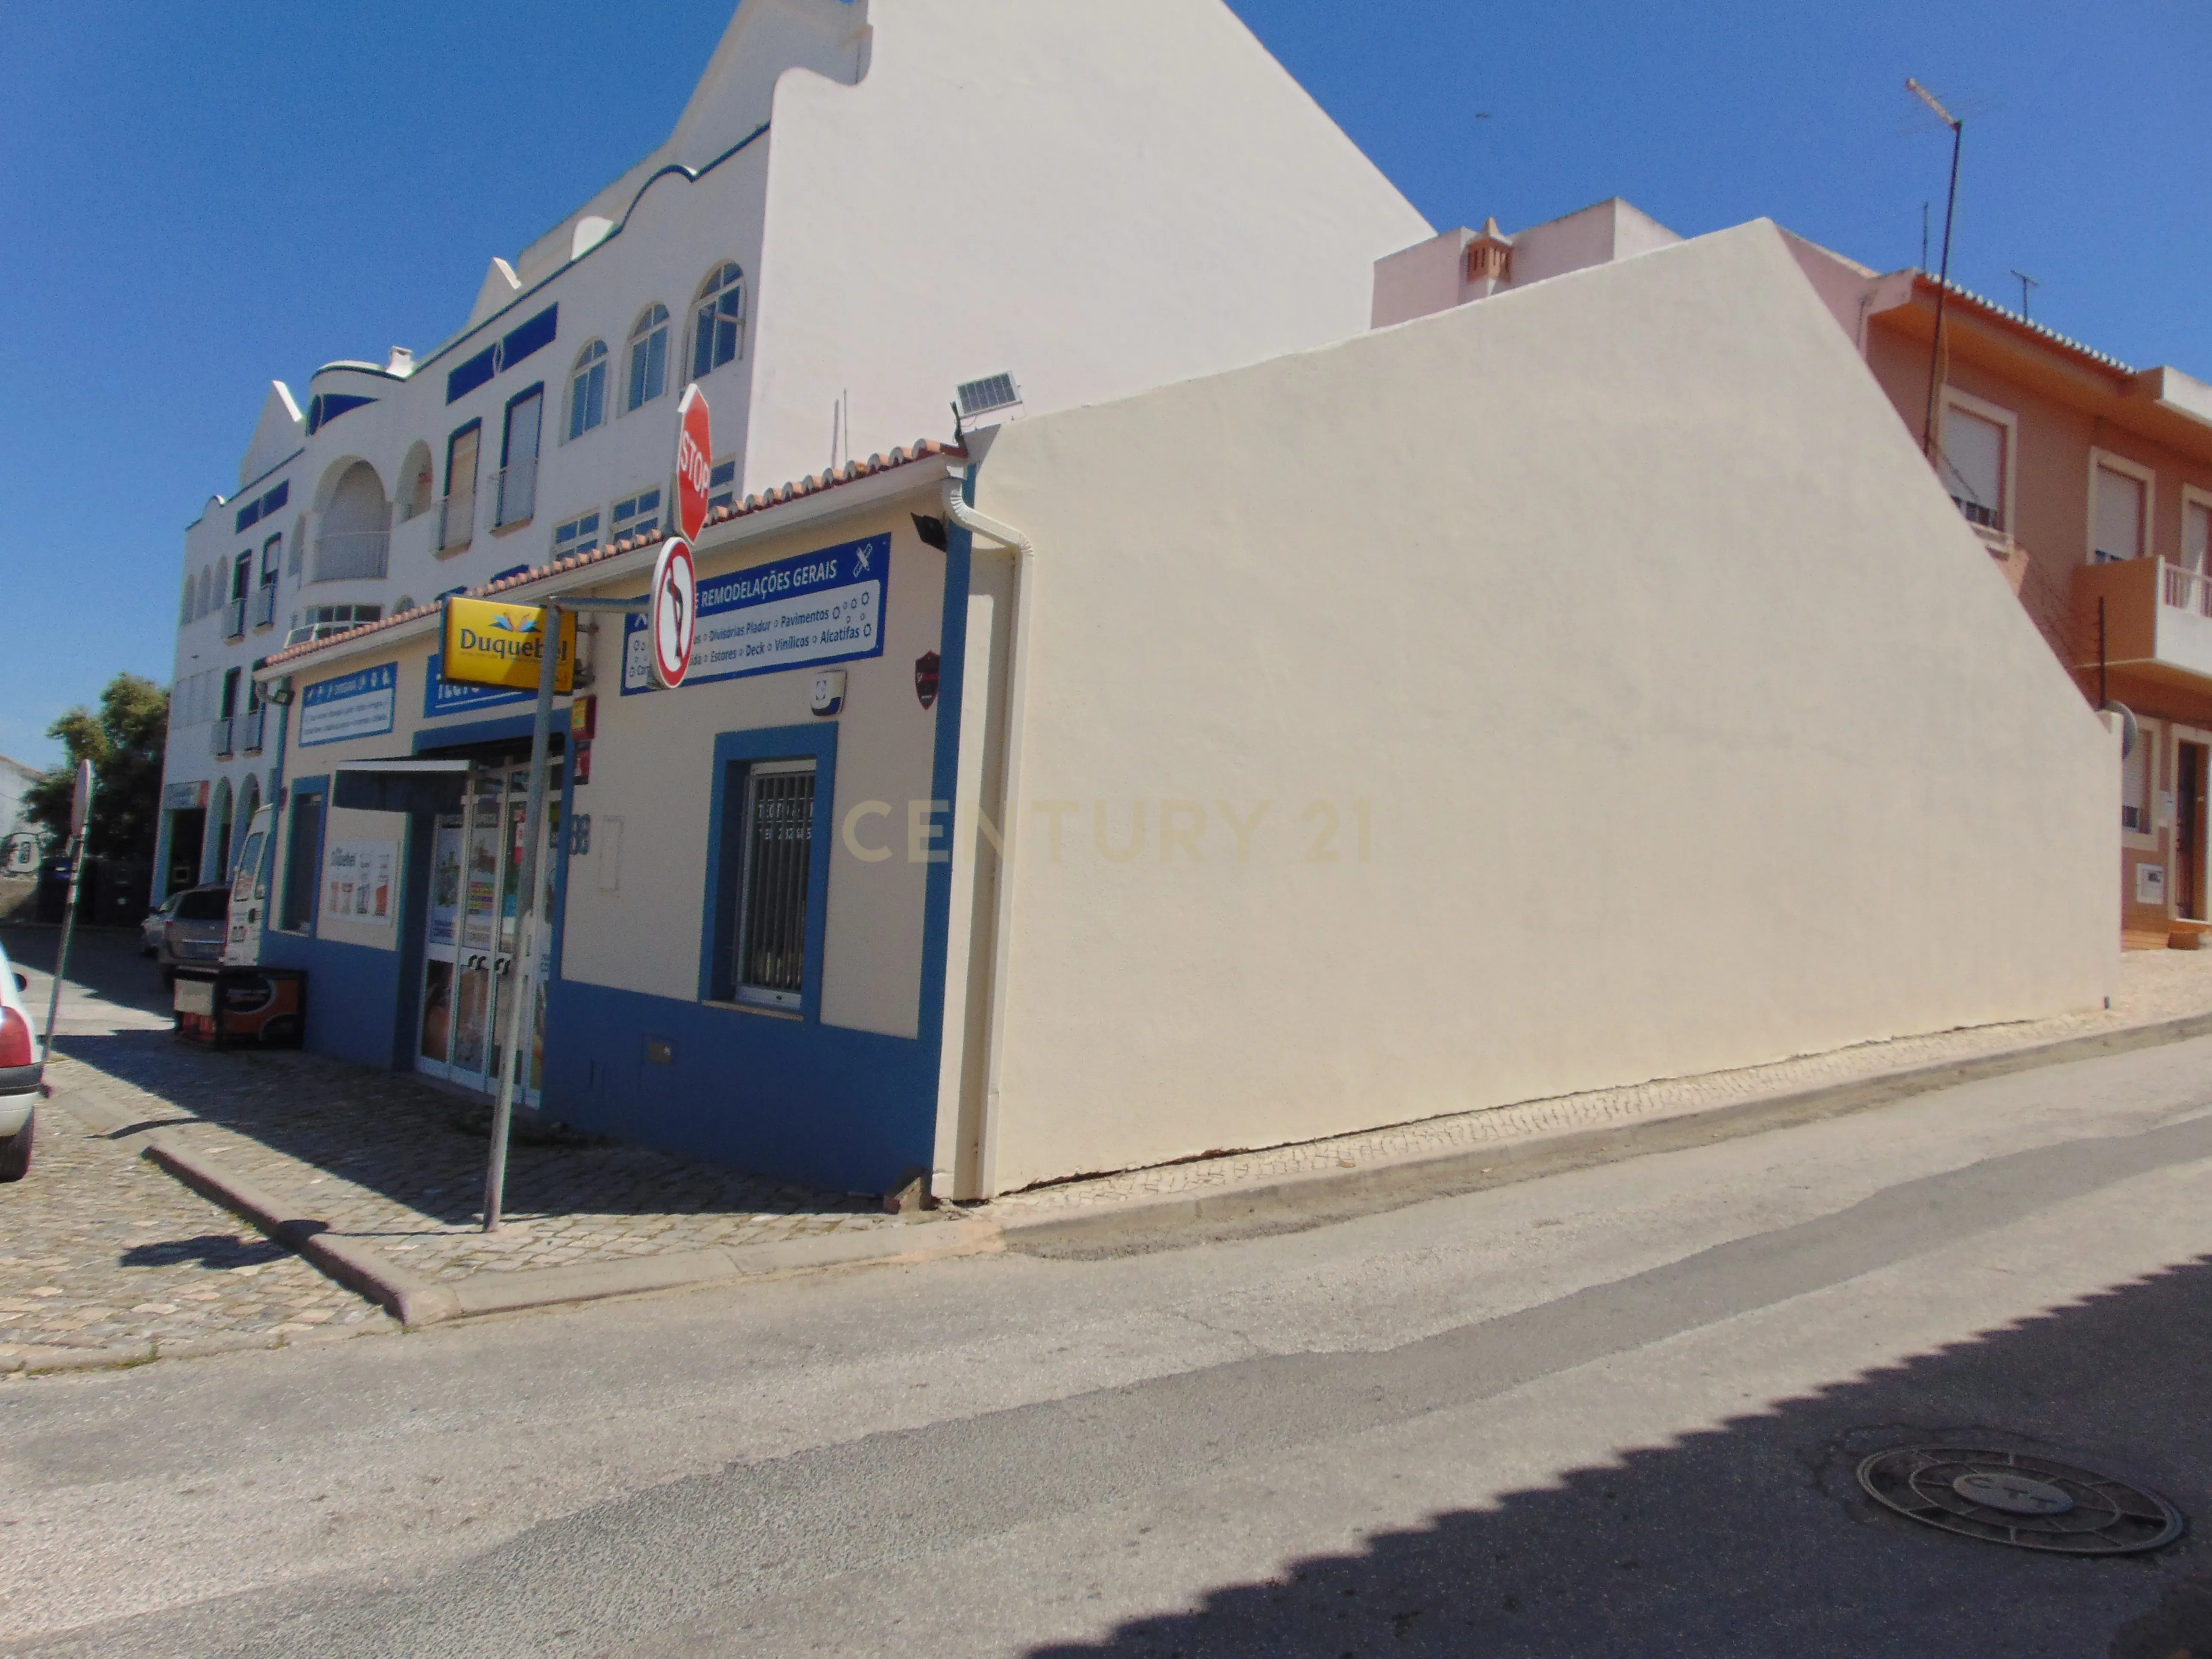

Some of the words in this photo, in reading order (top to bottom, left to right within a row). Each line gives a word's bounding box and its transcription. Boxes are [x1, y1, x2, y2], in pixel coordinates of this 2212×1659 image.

[680, 430, 709, 498] STOP
[702, 570, 790, 607] REMODELAÇÕES
[793, 559, 837, 586] GERAIS
[746, 620, 771, 635] Pladur
[780, 610, 829, 628] Pavimentos
[710, 650, 736, 662] Estores
[746, 642, 765, 656] Deck
[820, 626, 860, 644] Alcatifas
